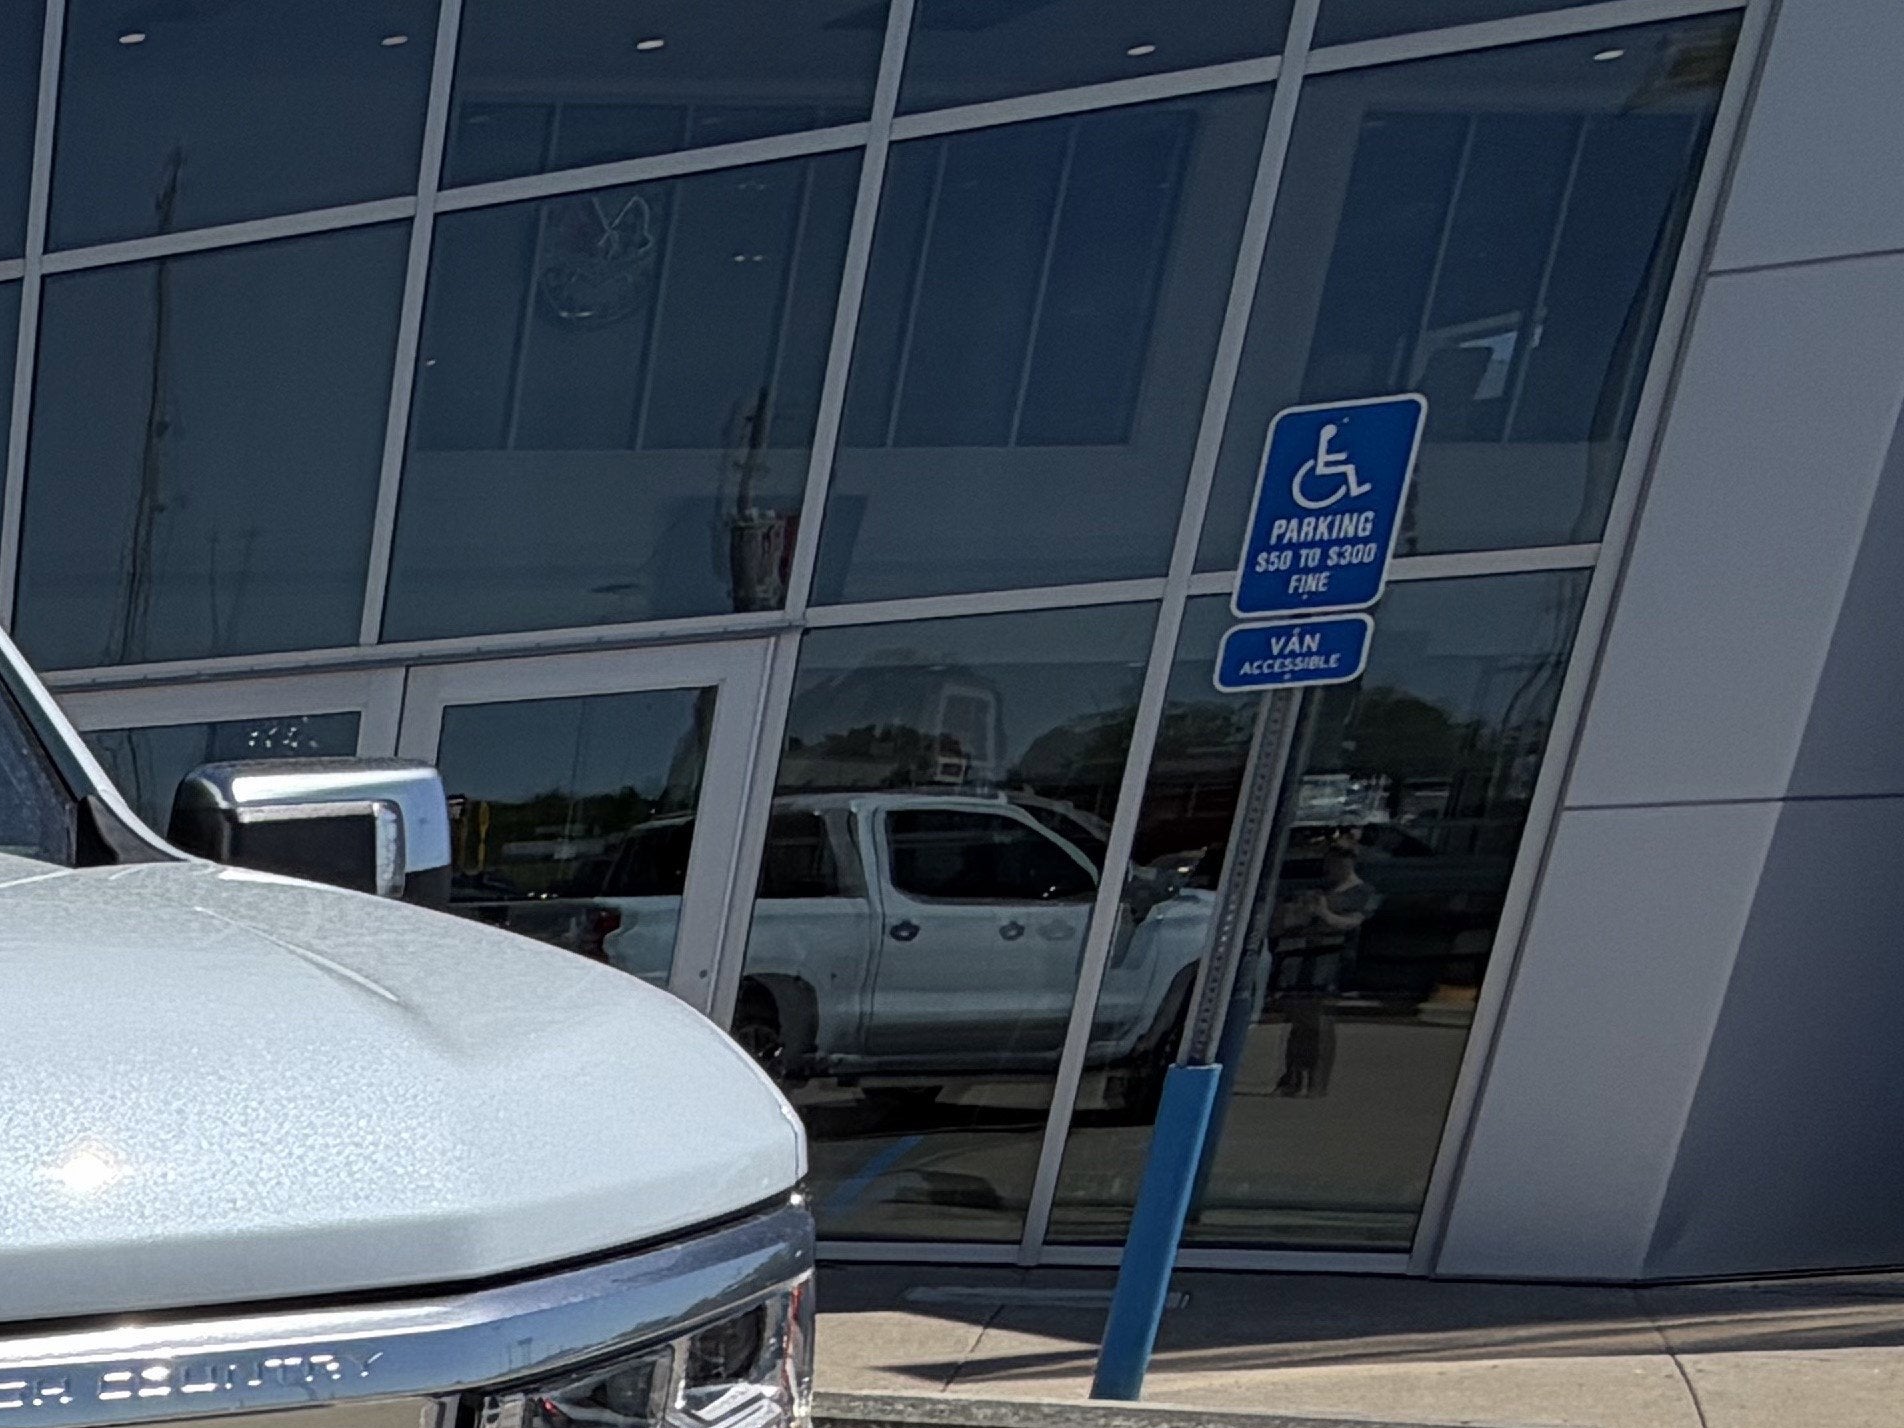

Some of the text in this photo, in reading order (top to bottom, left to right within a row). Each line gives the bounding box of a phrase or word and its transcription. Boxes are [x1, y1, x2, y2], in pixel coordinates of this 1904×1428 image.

[1269, 510, 1375, 546] PARKING
[1255, 543, 1377, 572] $50 TO $300
[1288, 572, 1330, 594] FINE
[1270, 633, 1321, 656] VAN
[1239, 653, 1341, 676] ACCESSIBLE
